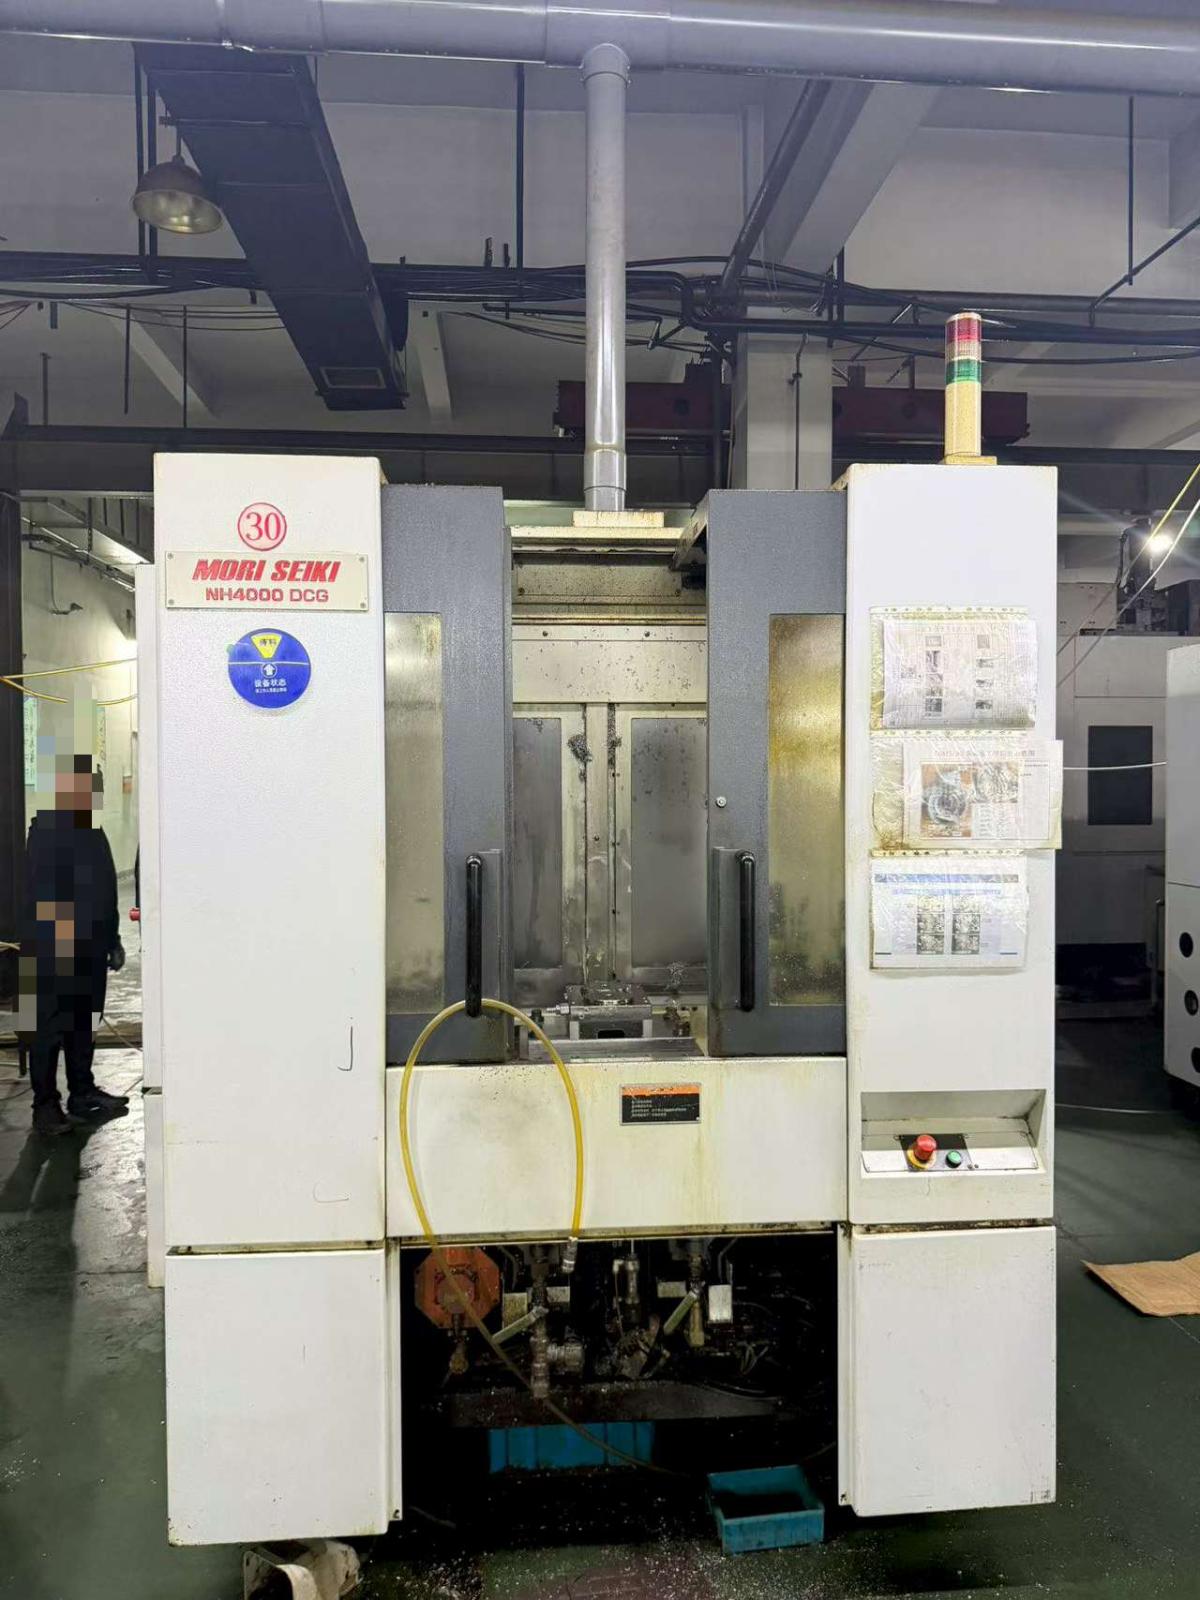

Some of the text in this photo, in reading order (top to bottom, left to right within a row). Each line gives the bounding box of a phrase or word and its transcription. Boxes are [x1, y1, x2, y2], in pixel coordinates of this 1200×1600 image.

[246, 511, 281, 541] 30
[192, 559, 342, 583] MORI SEIKI
[206, 587, 329, 603] NH4000 DCG
